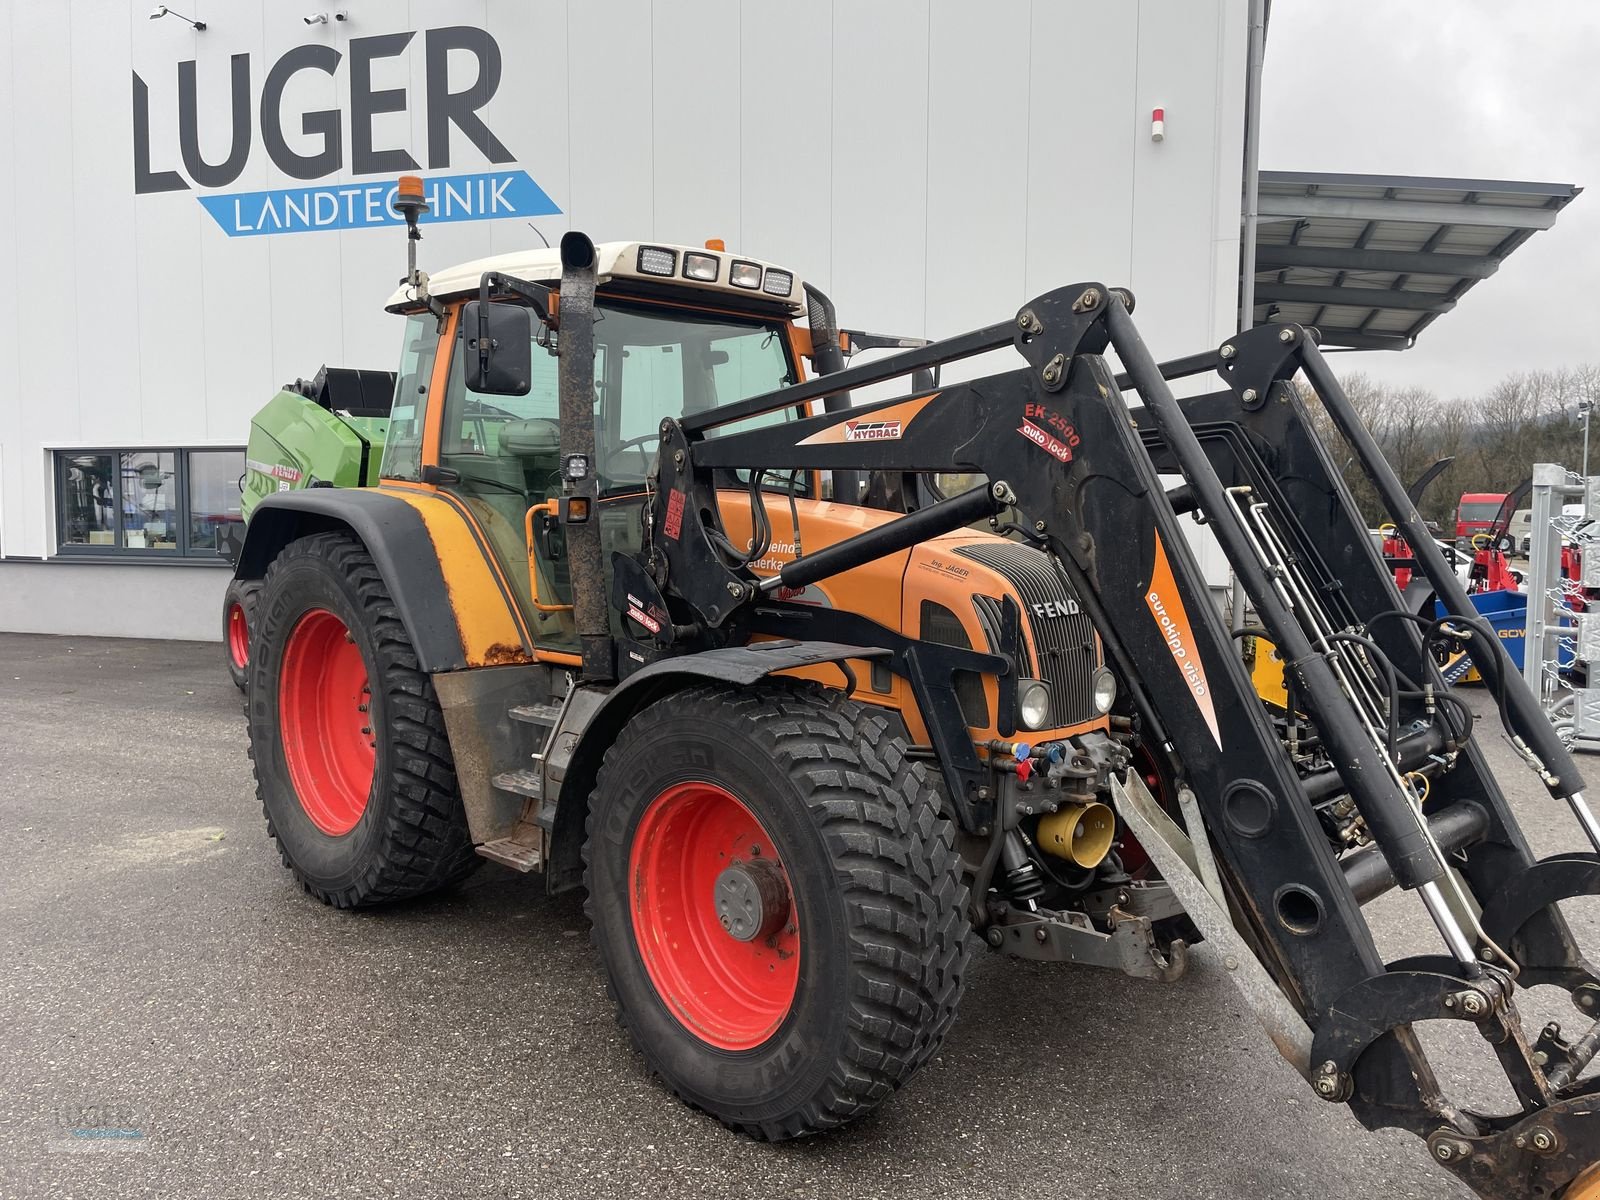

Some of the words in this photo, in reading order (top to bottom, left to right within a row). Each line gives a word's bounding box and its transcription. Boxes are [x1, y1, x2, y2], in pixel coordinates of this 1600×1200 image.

[132, 26, 518, 194] LUGER
[234, 177, 516, 233] LANDTECHNIK
[854, 428, 898, 439] HYDRAC
[1023, 425, 1045, 443] auto
[1047, 439, 1068, 460] lock
[1025, 403, 1046, 418] EK
[1048, 412, 1080, 447] 2500
[1032, 600, 1080, 618] FEND
[1149, 592, 1187, 659] eurokipp
[1183, 660, 1206, 697] visio
